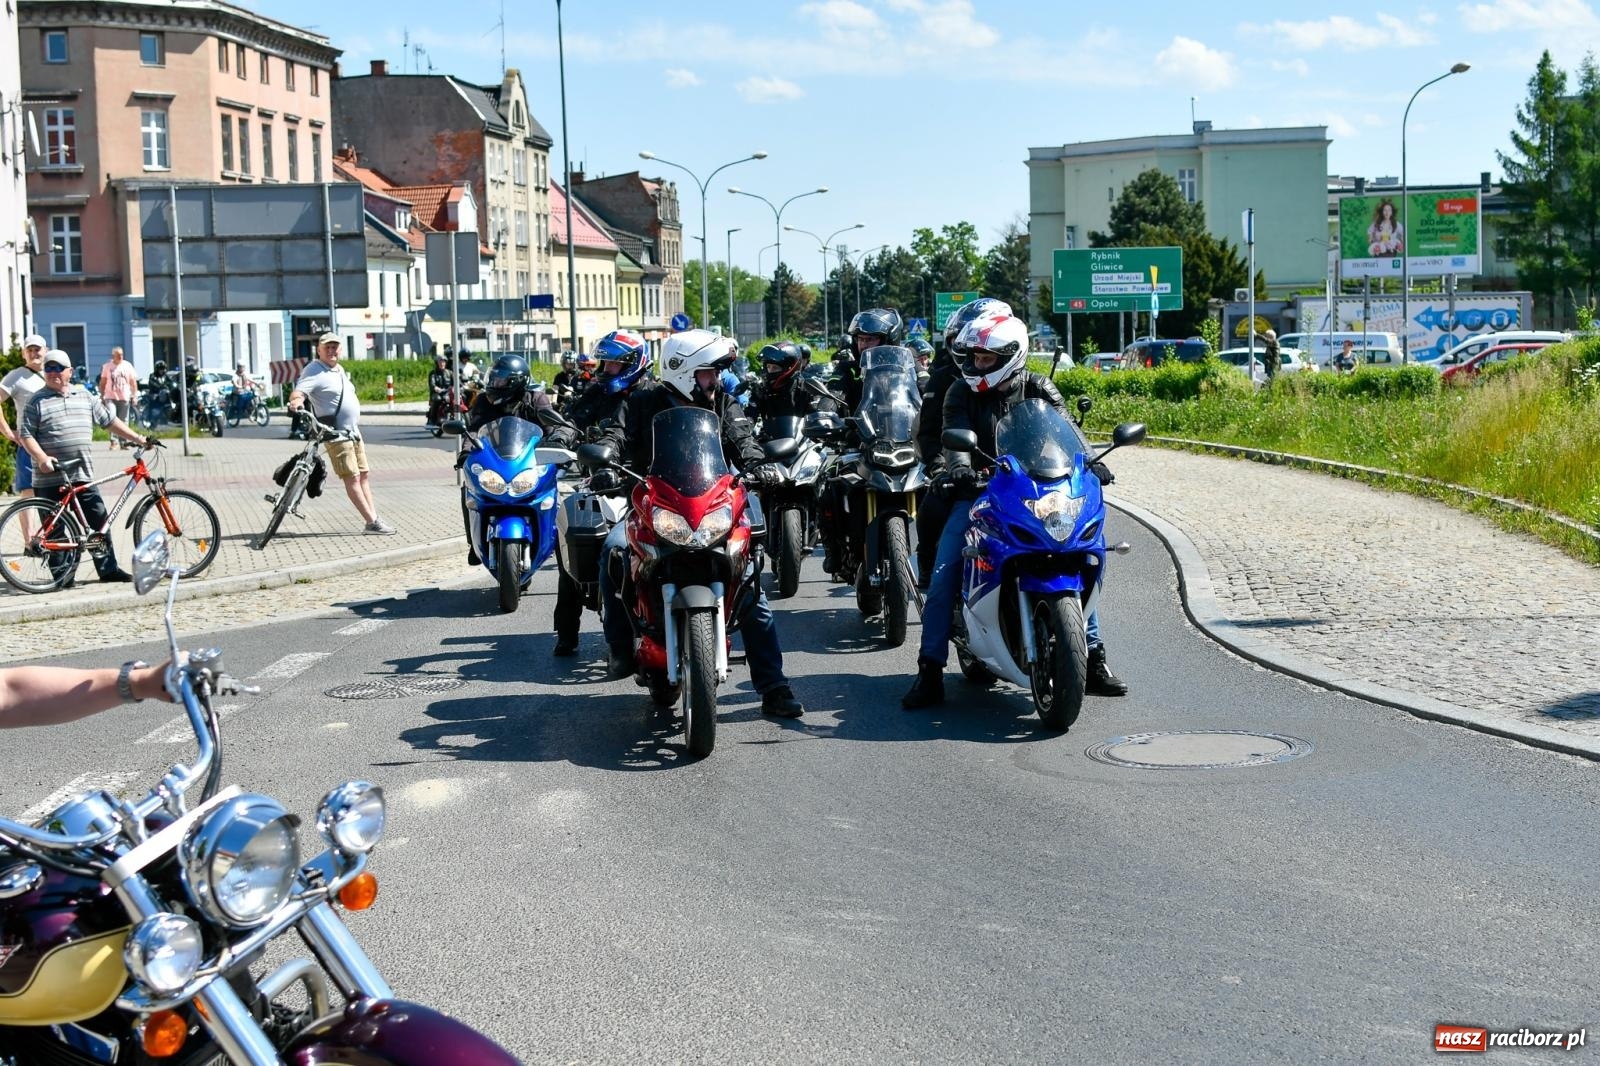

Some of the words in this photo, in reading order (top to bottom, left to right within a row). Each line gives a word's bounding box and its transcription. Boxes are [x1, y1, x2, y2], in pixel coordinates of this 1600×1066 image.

[1091, 251, 1121, 261] Rybnik
[1091, 262, 1124, 271] Gliwice
[1117, 273, 1142, 282] Miejski
[1132, 284, 1169, 293] Powiaowe
[1073, 301, 1083, 309] 45
[1091, 299, 1119, 309] Opole
